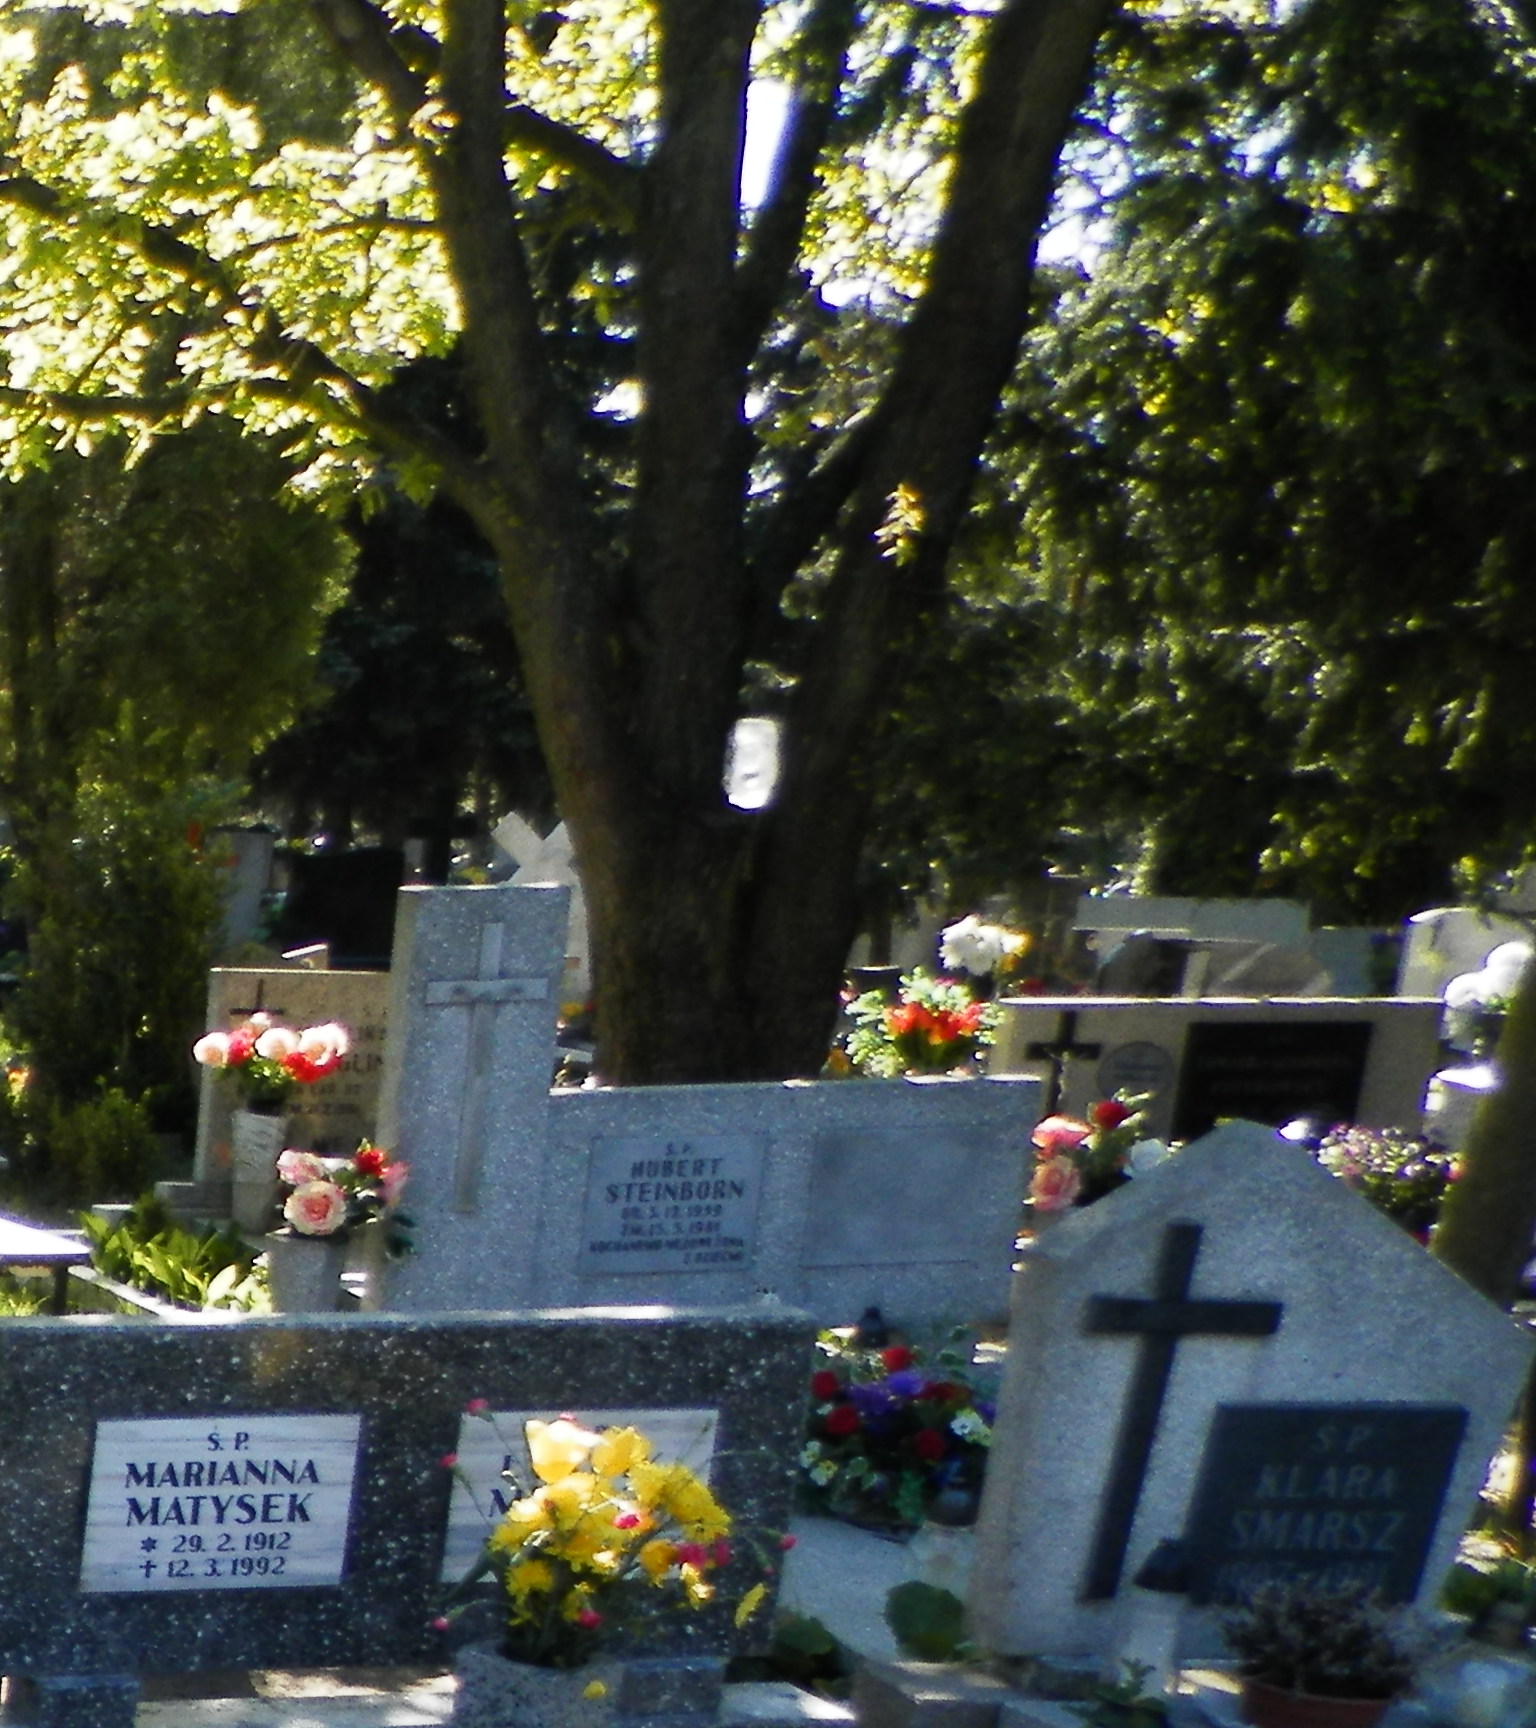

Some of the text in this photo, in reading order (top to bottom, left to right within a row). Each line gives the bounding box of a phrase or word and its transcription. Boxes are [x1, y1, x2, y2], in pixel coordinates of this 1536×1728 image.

[631, 1158, 723, 1179] HUBERT
[605, 1179, 744, 1204] STEINBORN
[125, 1458, 321, 1489] MARIANNA
[1255, 1463, 1399, 1499] KLARA
[126, 1492, 315, 1527] MATYSEK
